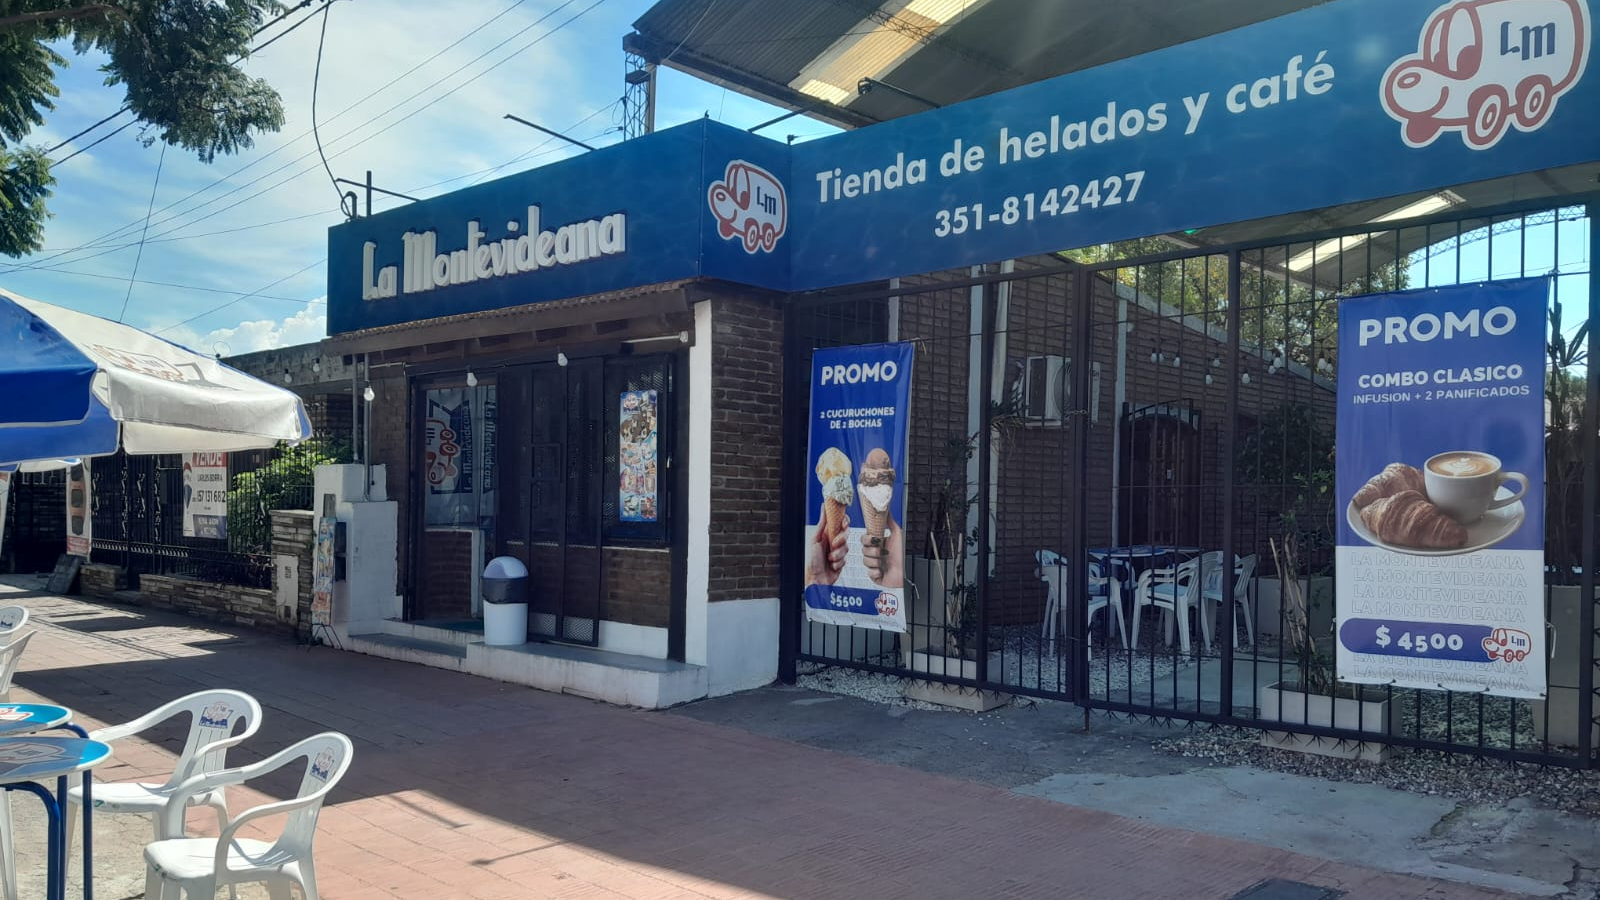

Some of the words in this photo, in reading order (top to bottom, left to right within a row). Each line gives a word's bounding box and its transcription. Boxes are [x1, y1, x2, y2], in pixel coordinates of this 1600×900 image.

[816, 152, 926, 203] Tienda
[940, 138, 985, 177] de
[1000, 101, 1168, 165] helados
[1182, 92, 1210, 135] y
[1225, 50, 1335, 114] café
[935, 170, 1146, 238] 351-8142427
[362, 241, 398, 301] La
[402, 205, 626, 293] Montevideana
[1359, 305, 1517, 347] PROMO
[821, 360, 897, 386] PROMO
[1358, 370, 1429, 389] COMBO
[1433, 364, 1523, 384] CLASICO
[1353, 392, 1411, 404] INFUSION
[1425, 390, 1433, 401] 2
[1436, 385, 1530, 400] PANIFICADOS
[826, 406, 895, 419] CUCURUCHONES
[830, 420, 841, 429] DE
[848, 418, 882, 429] BOCHAS
[1397, 632, 1464, 652] 4500
